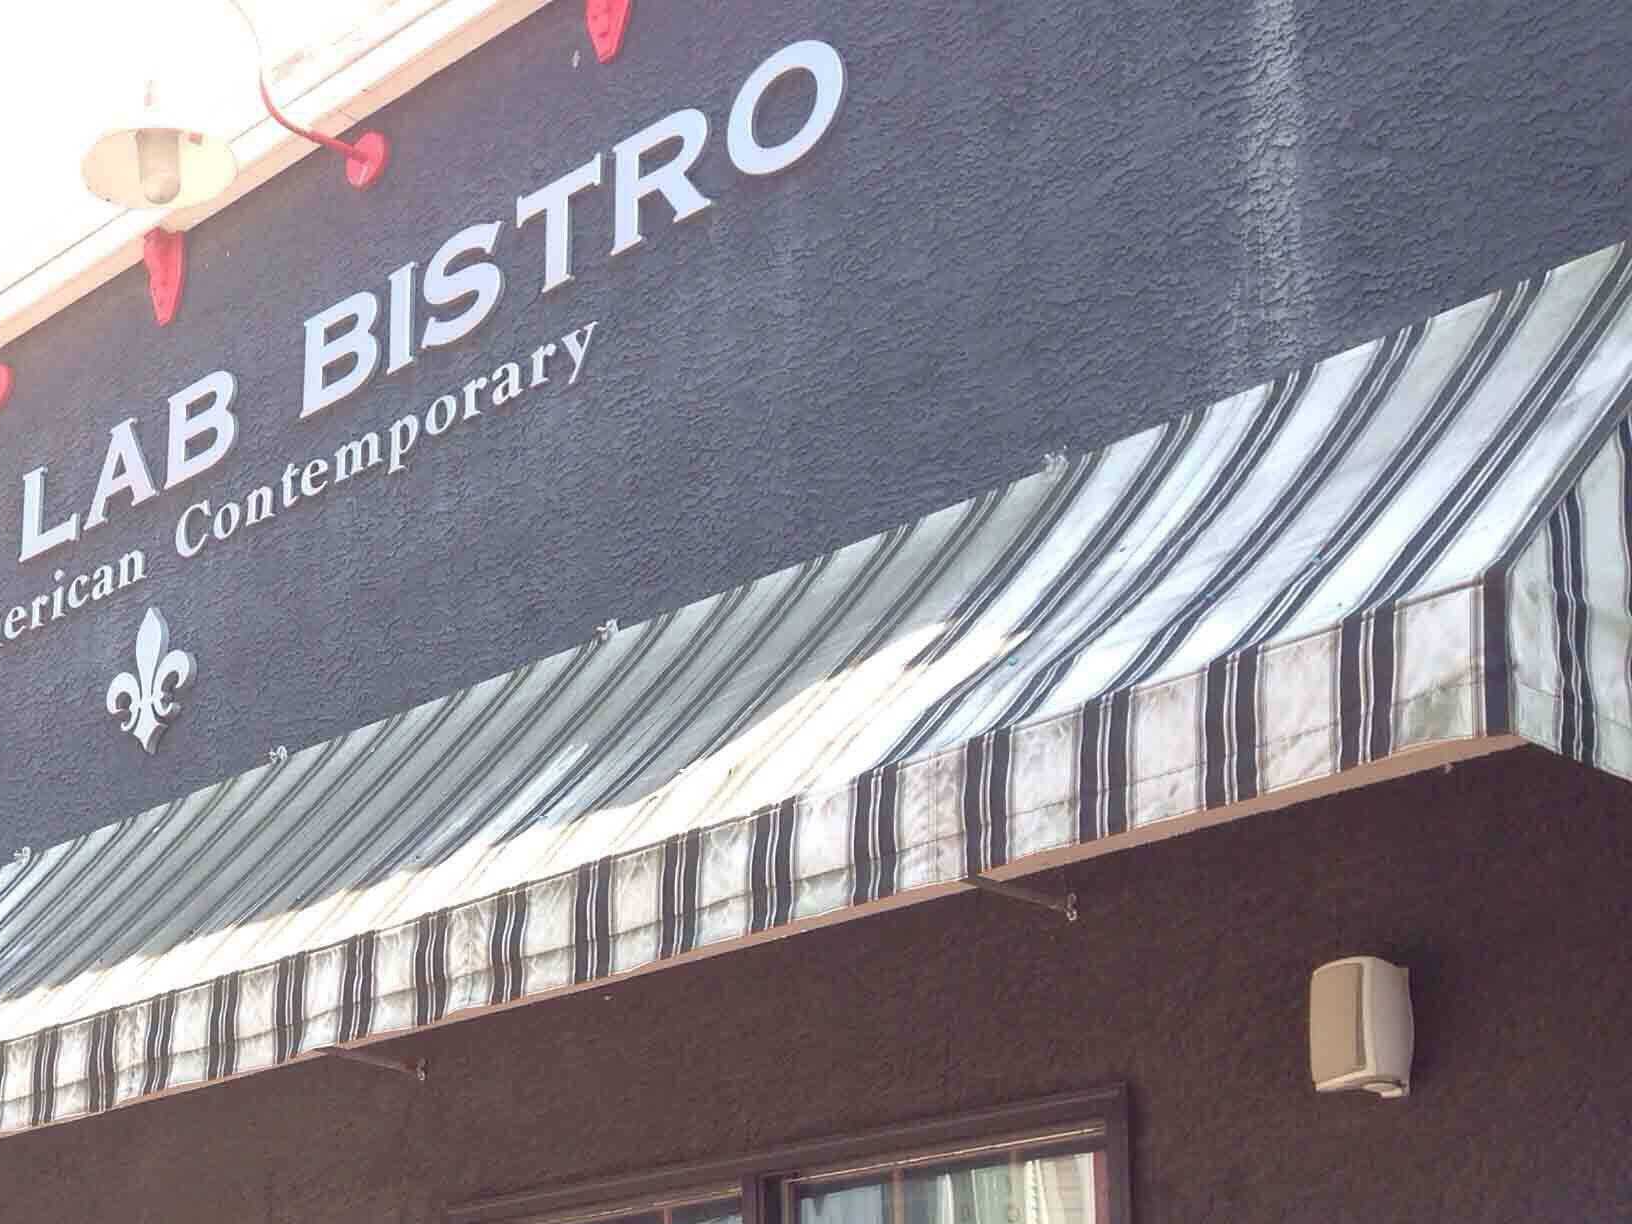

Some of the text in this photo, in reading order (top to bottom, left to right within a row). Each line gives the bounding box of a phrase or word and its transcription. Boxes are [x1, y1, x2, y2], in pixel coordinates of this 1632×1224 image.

[19, 370, 238, 563] LAB
[301, 39, 847, 419] BISTRO
[173, 321, 599, 558] Contemporary
